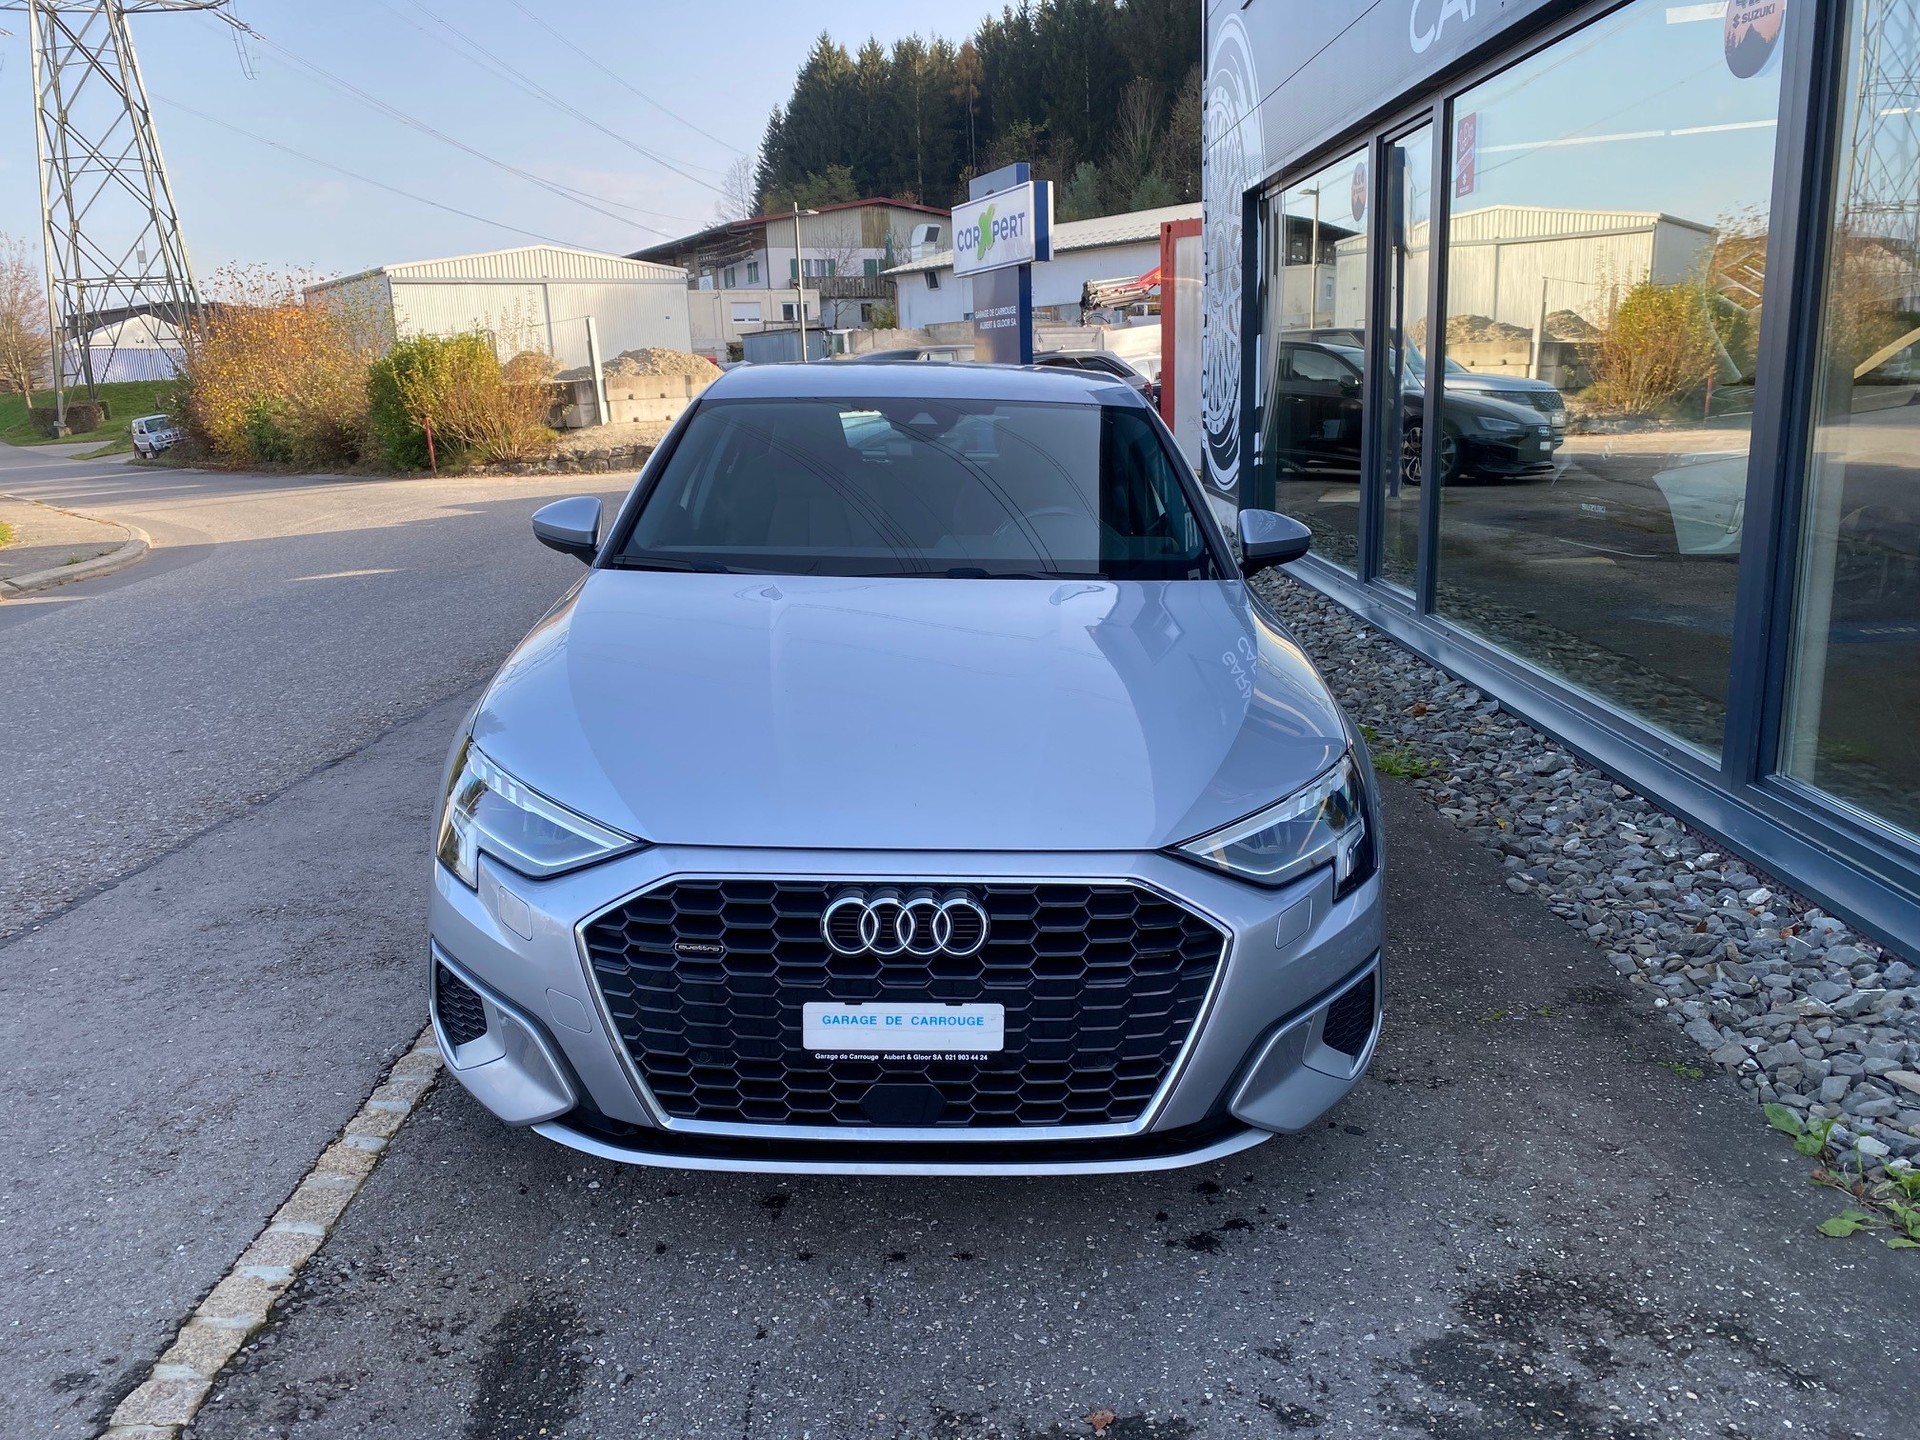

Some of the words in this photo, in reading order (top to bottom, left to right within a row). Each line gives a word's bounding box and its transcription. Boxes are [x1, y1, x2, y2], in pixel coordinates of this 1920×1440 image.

[1741, 3, 1776, 24] SUZUKI
[975, 309, 989, 319] GARAGE
[989, 308, 995, 317] DE
[995, 305, 1017, 316] CARROUGE
[1010, 317, 1017, 327] SA
[678, 944, 720, 952] quattro
[822, 1015, 878, 1025] GARAGE
[885, 1016, 902, 1025] DE
[911, 1016, 984, 1026] CARROUGE
[814, 1053, 839, 1061] Garage
[849, 1053, 879, 1061] Carrouge
